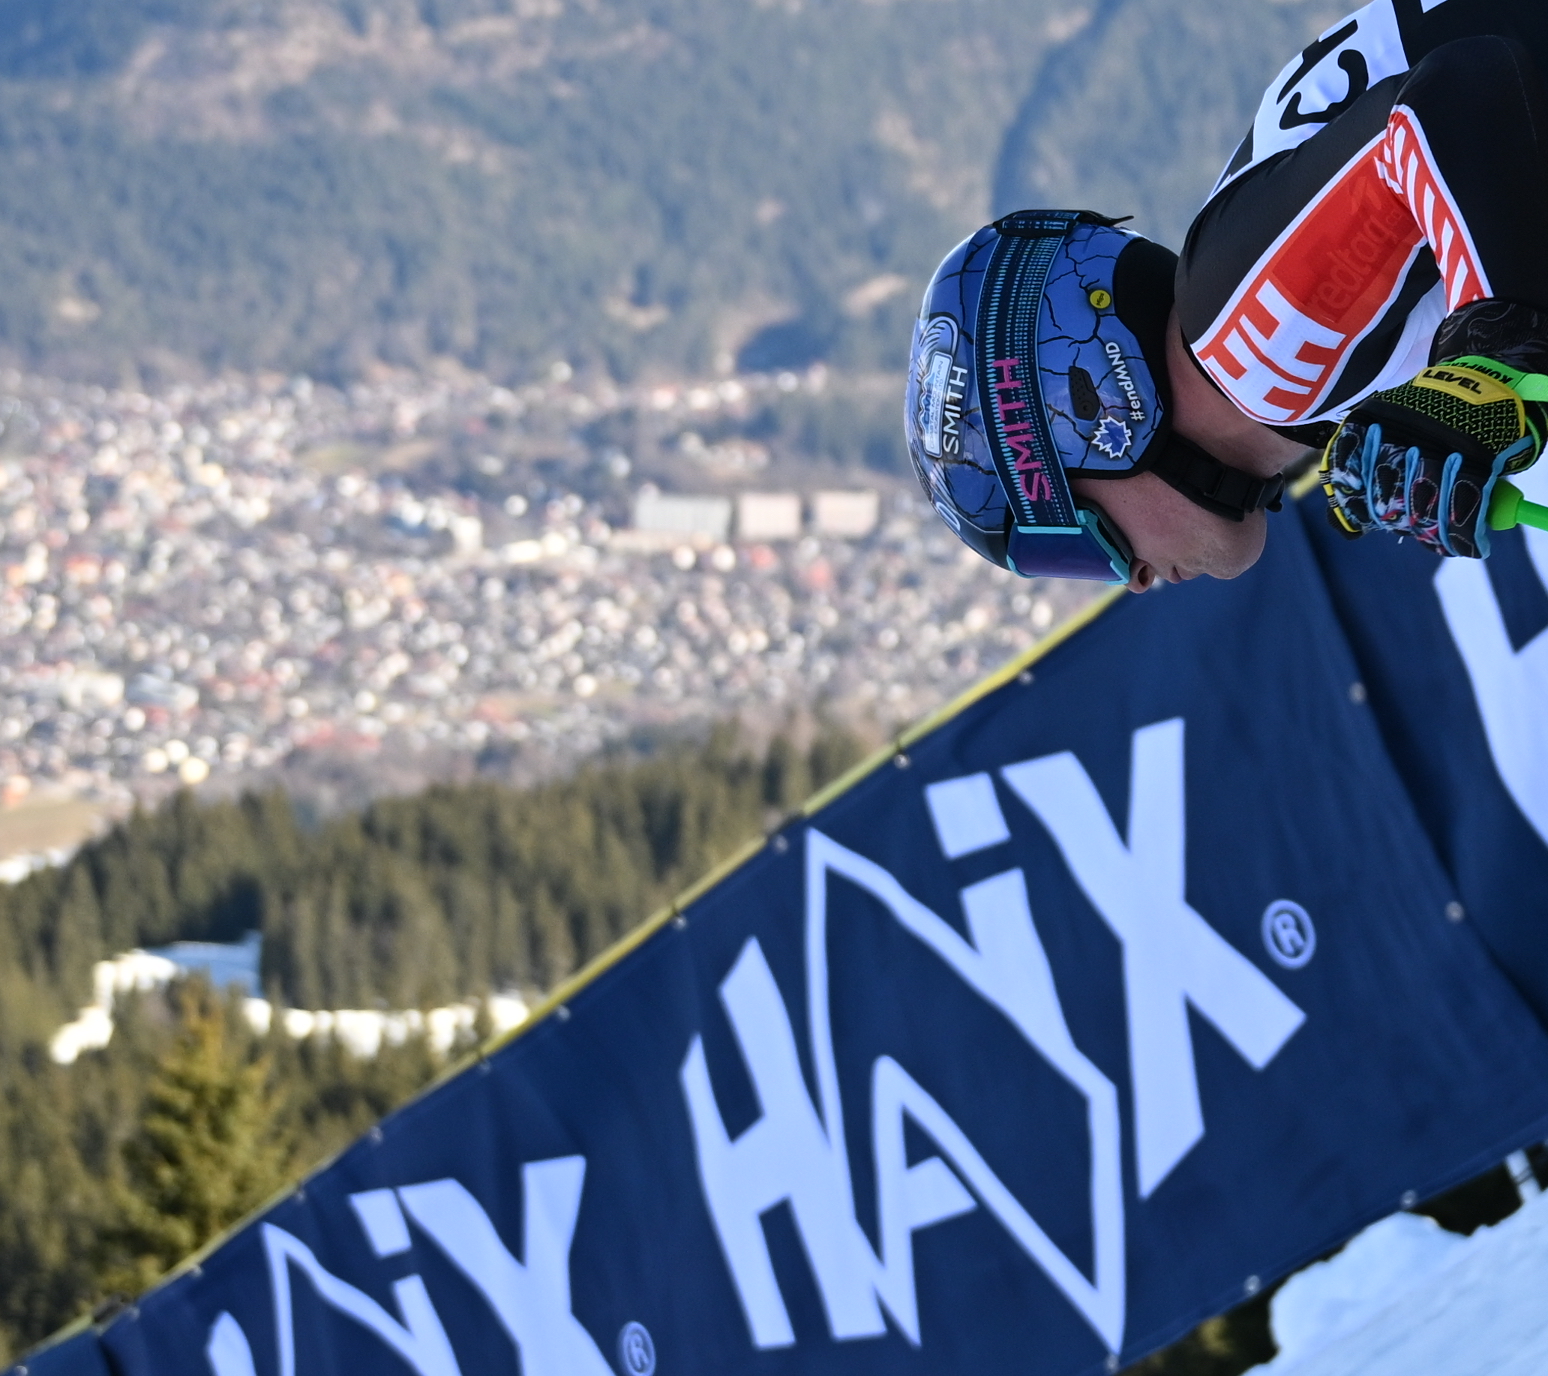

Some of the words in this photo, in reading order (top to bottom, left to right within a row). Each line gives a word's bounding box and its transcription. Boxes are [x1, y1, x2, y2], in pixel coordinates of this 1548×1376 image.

[941, 365, 969, 456] SMITH
[1105, 340, 1146, 422] #endMND
[1422, 368, 1483, 395] LEVEL
[992, 357, 1052, 502] SMITH
